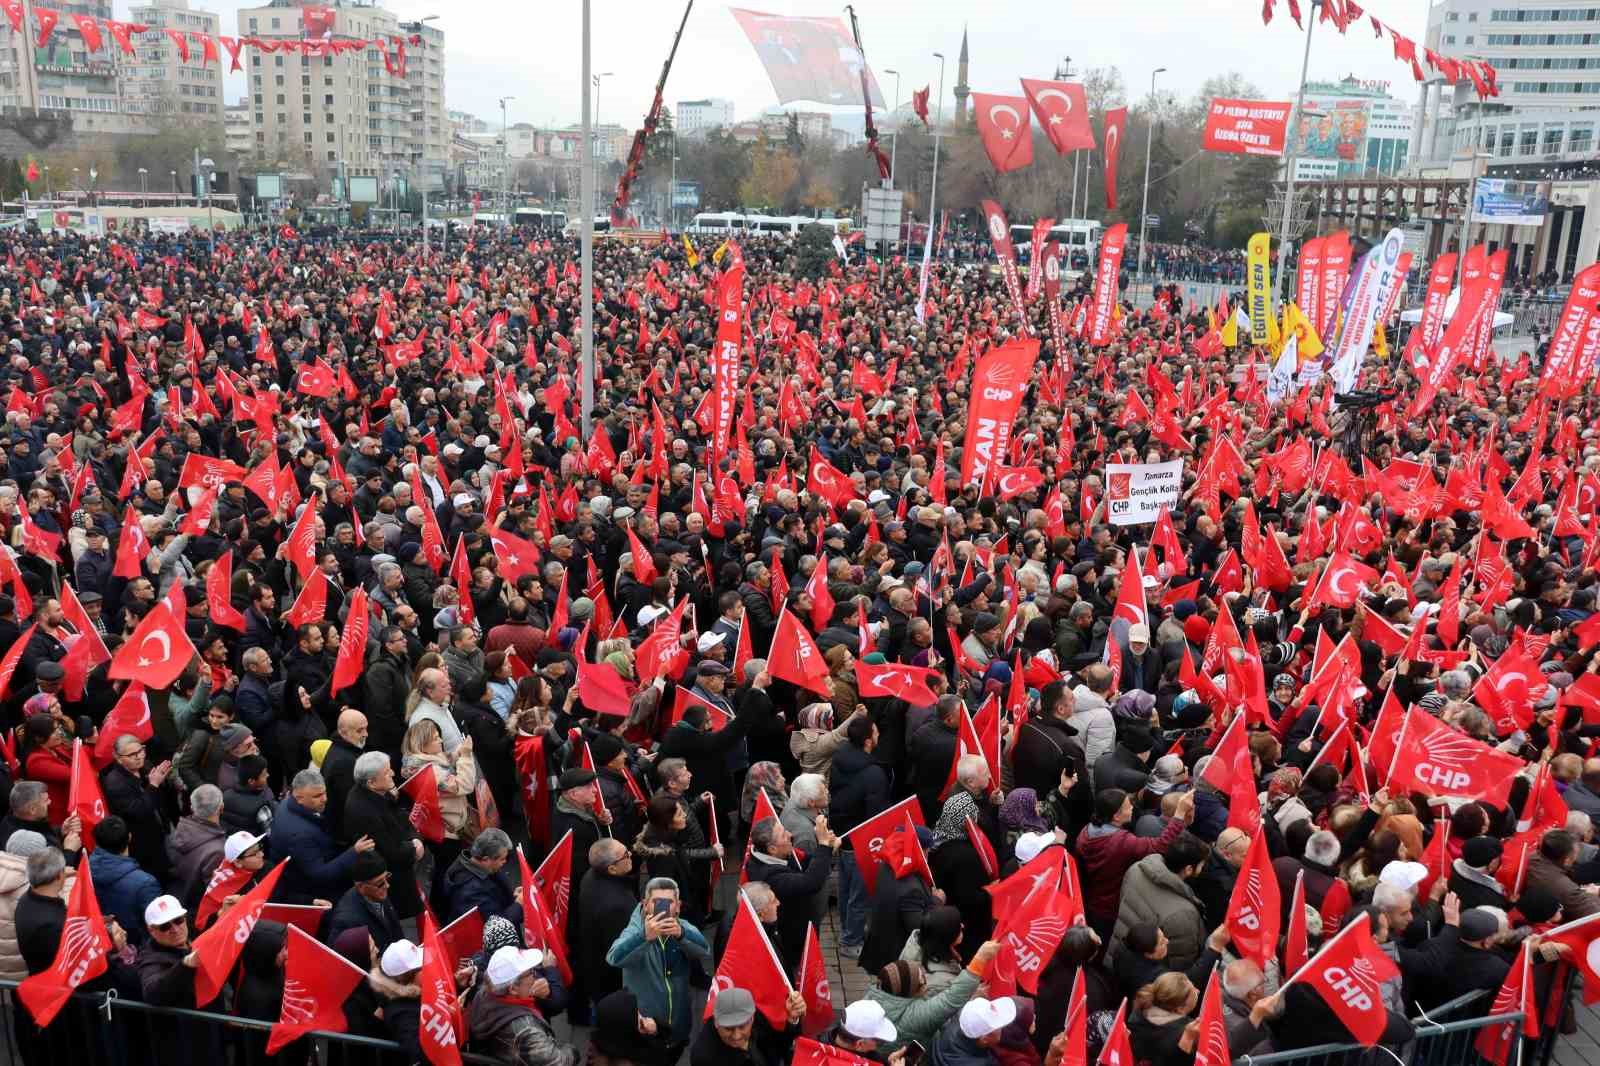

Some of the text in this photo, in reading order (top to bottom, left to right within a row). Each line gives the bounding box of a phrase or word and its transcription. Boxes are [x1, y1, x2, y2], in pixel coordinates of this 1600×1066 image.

[1254, 263, 1264, 290] SEN
[1578, 288, 1597, 298] CHP
[984, 387, 1013, 401] CHP
[1130, 486, 1158, 496] Gençlik
[1112, 501, 1129, 513] CHP
[1414, 763, 1472, 790] CHP
[1236, 905, 1258, 931] HP
[1006, 932, 1040, 973] CHP
[1323, 966, 1372, 1012] CHP
